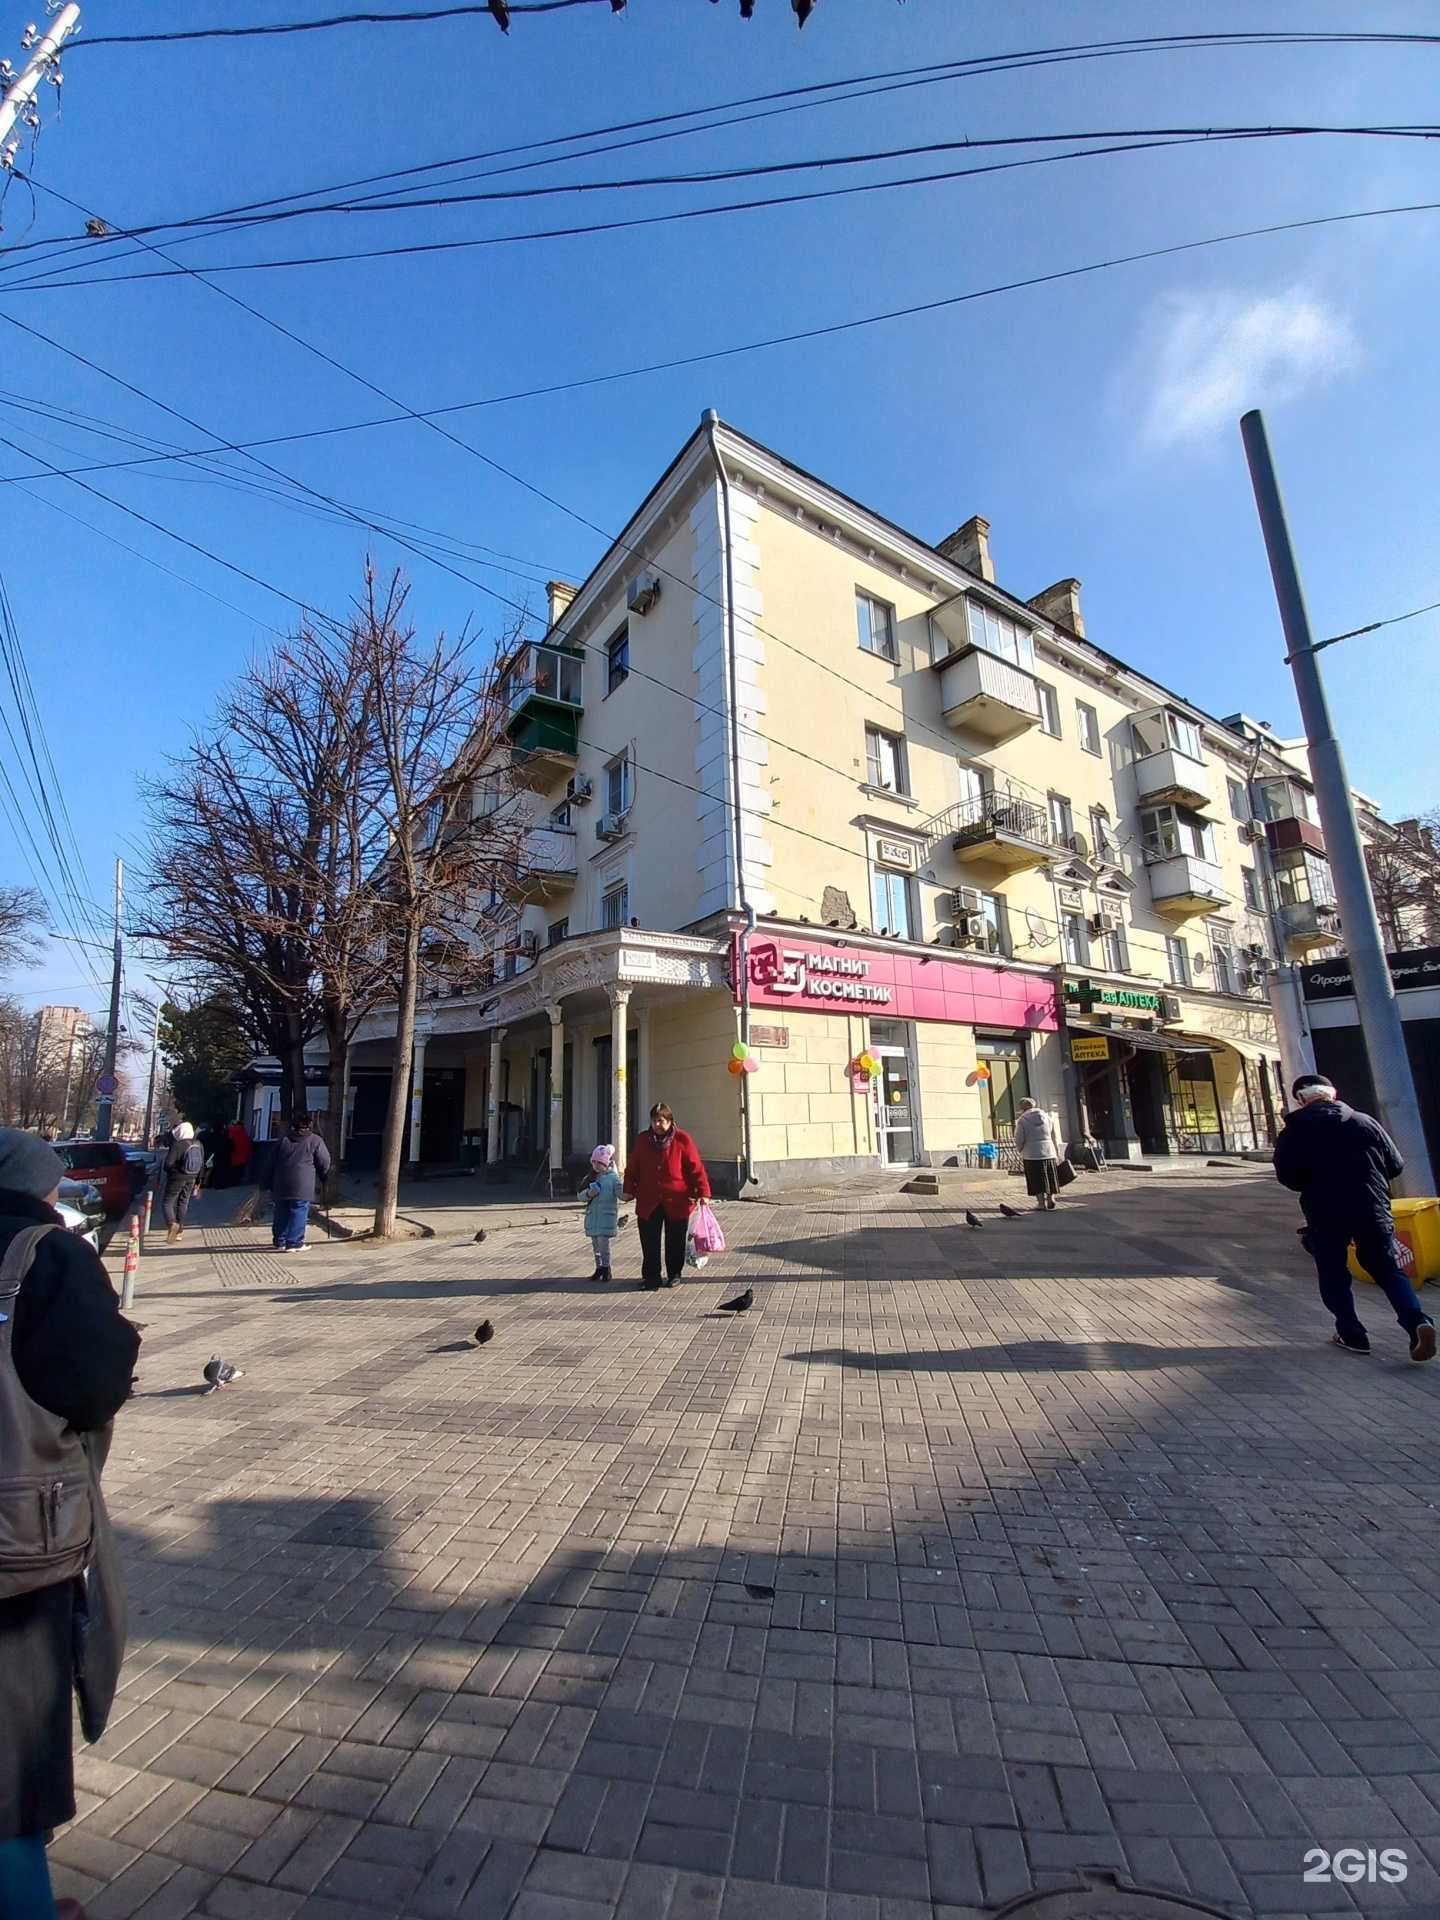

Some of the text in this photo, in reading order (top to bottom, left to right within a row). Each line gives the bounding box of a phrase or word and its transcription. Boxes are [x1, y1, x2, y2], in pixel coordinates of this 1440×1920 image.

[808, 953, 871, 976] МАГНИТ
[808, 978, 893, 1001] КОСМЕТИК
[1119, 991, 1160, 1009] АПТЕКА
